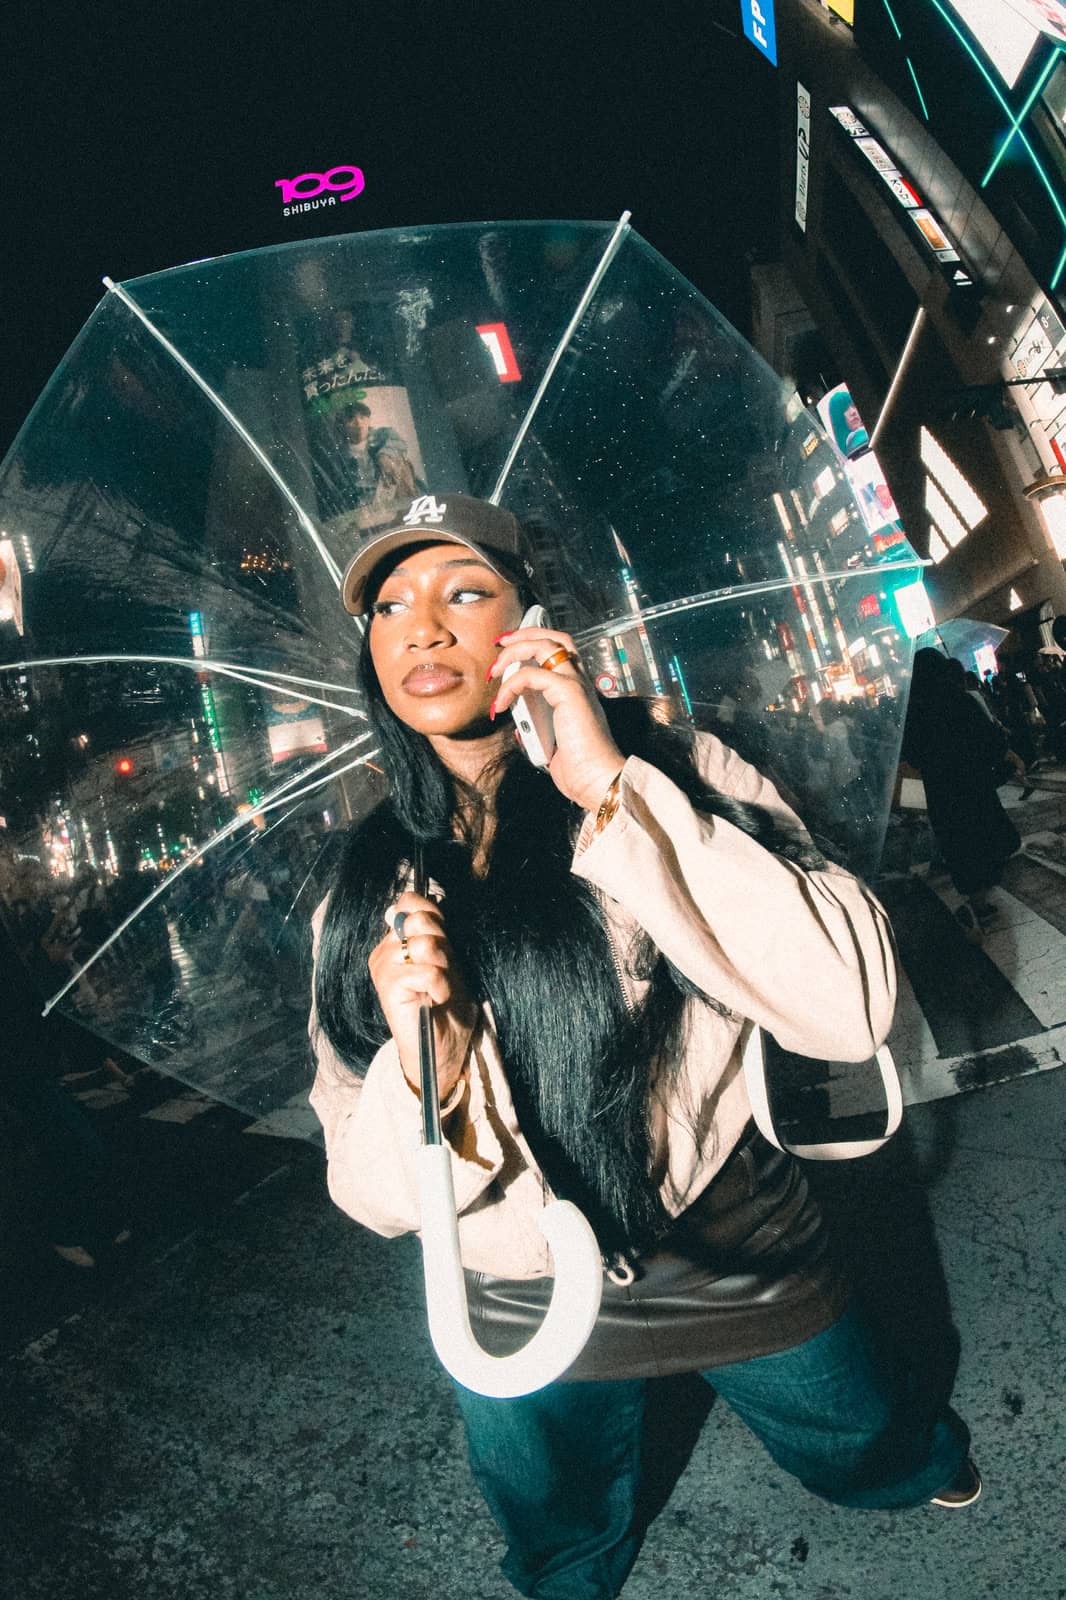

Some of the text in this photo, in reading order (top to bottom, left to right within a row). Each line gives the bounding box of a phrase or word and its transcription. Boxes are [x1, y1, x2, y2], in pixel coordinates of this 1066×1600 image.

[274, 165, 365, 203] 109
[283, 196, 336, 217] SHIBUYA
[402, 494, 447, 526] LA
